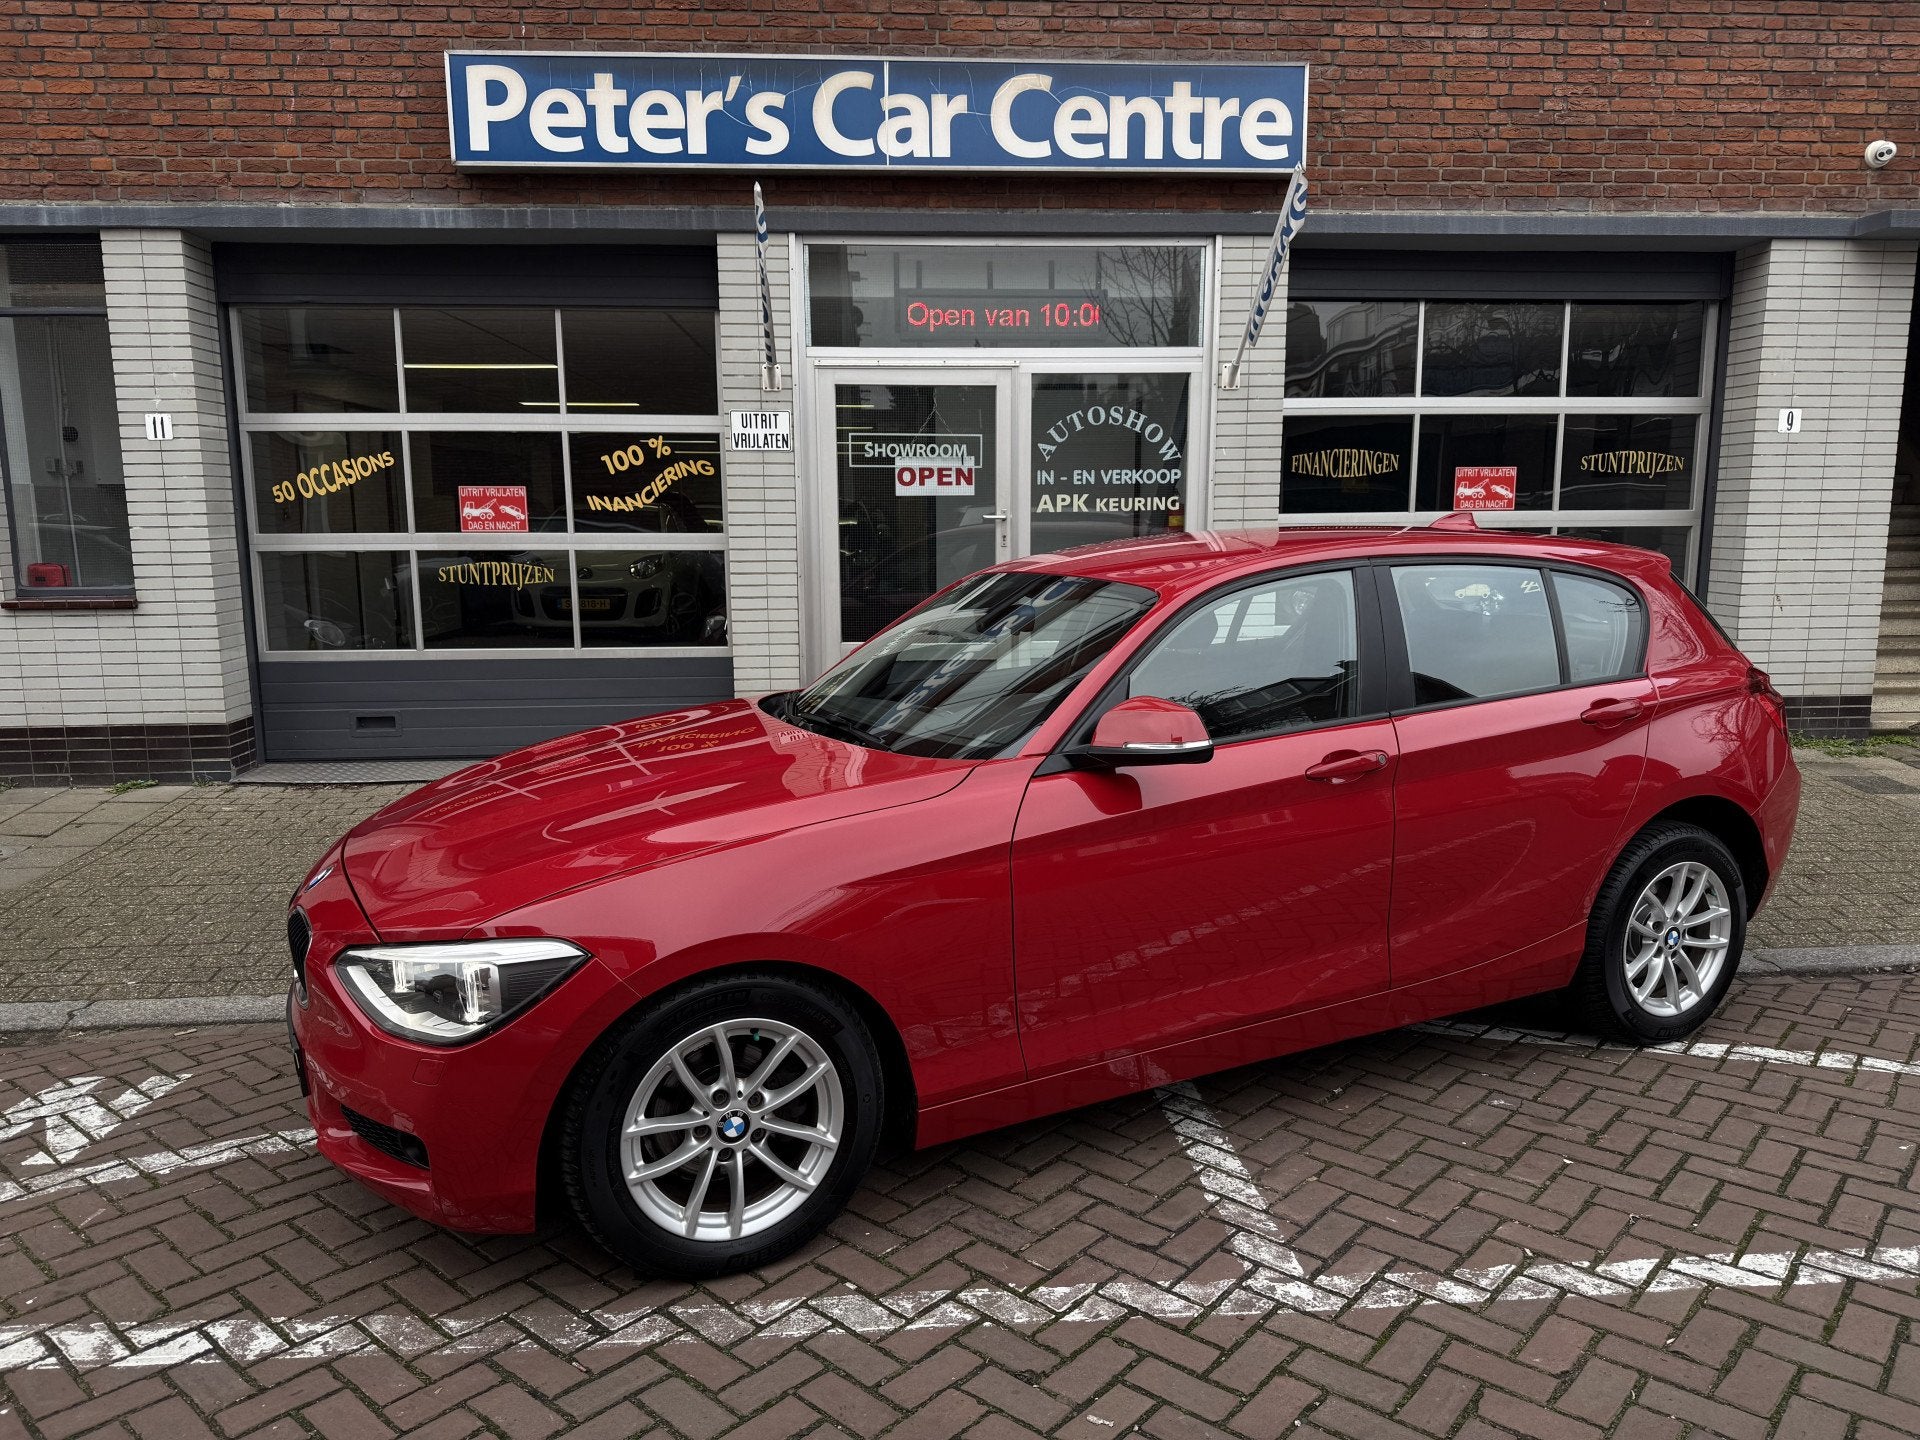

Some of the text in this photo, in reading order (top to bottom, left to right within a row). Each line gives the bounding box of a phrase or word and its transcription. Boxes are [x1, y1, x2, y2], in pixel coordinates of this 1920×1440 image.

[465, 64, 1293, 161] Peter's Car Centre
[907, 302, 975, 332] Open
[984, 308, 1030, 327] van
[741, 413, 779, 430] UITRIT
[1786, 410, 1794, 432] 9
[733, 432, 790, 450] VRIJLATEN
[1037, 405, 1182, 462] AUTOSHOW
[601, 435, 672, 475] 100 %
[864, 441, 968, 459] SHOWROOM
[1291, 448, 1400, 478] FINANCIERINGEN
[1456, 468, 1516, 477] UITRIT VRIJLATEN
[1580, 450, 1685, 478] STUNTPRIJZEN
[272, 451, 395, 503] 50 OCCASIONS
[586, 459, 715, 512] INANCIERING
[896, 467, 974, 487] OPEN
[1037, 470, 1055, 485] IN
[1073, 470, 1095, 485] EN
[1100, 468, 1182, 485] VERKOOP
[461, 488, 525, 497] UITRIT VRIJLATEN
[1036, 493, 1180, 513] APK KEURING
[1460, 499, 1508, 508] DAG EN NACHT
[468, 521, 521, 530] DAG EN NACHT
[437, 561, 555, 591] STUNTPRIJZEN
